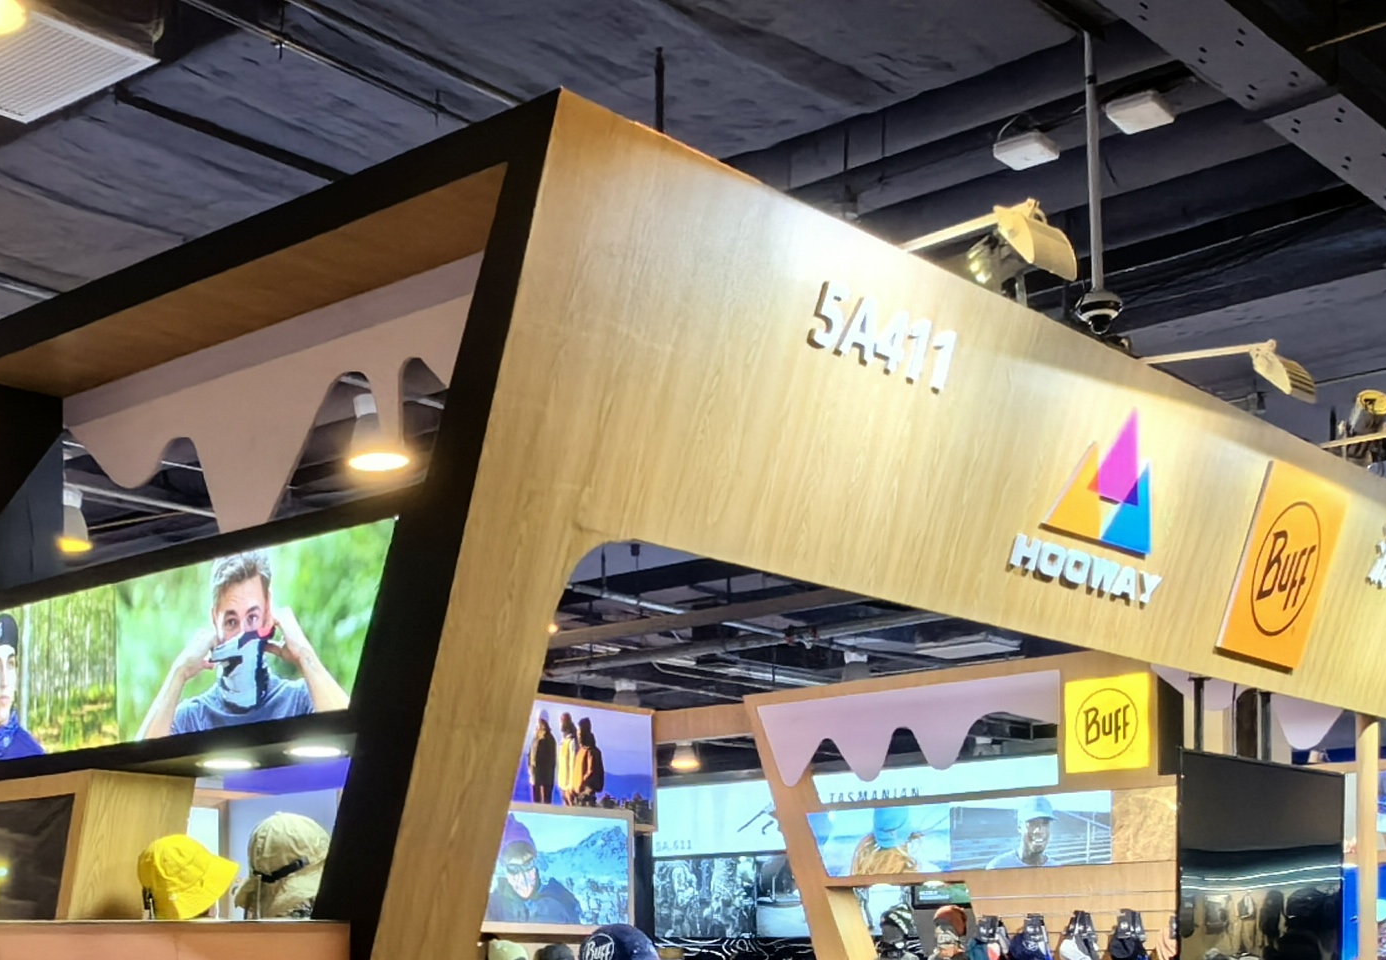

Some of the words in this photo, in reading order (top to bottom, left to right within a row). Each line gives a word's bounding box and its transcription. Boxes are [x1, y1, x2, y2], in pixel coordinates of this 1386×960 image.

[809, 280, 957, 393] 5A411
[1008, 533, 1162, 606] HOOWAY
[829, 787, 920, 804] TASMANIAN
